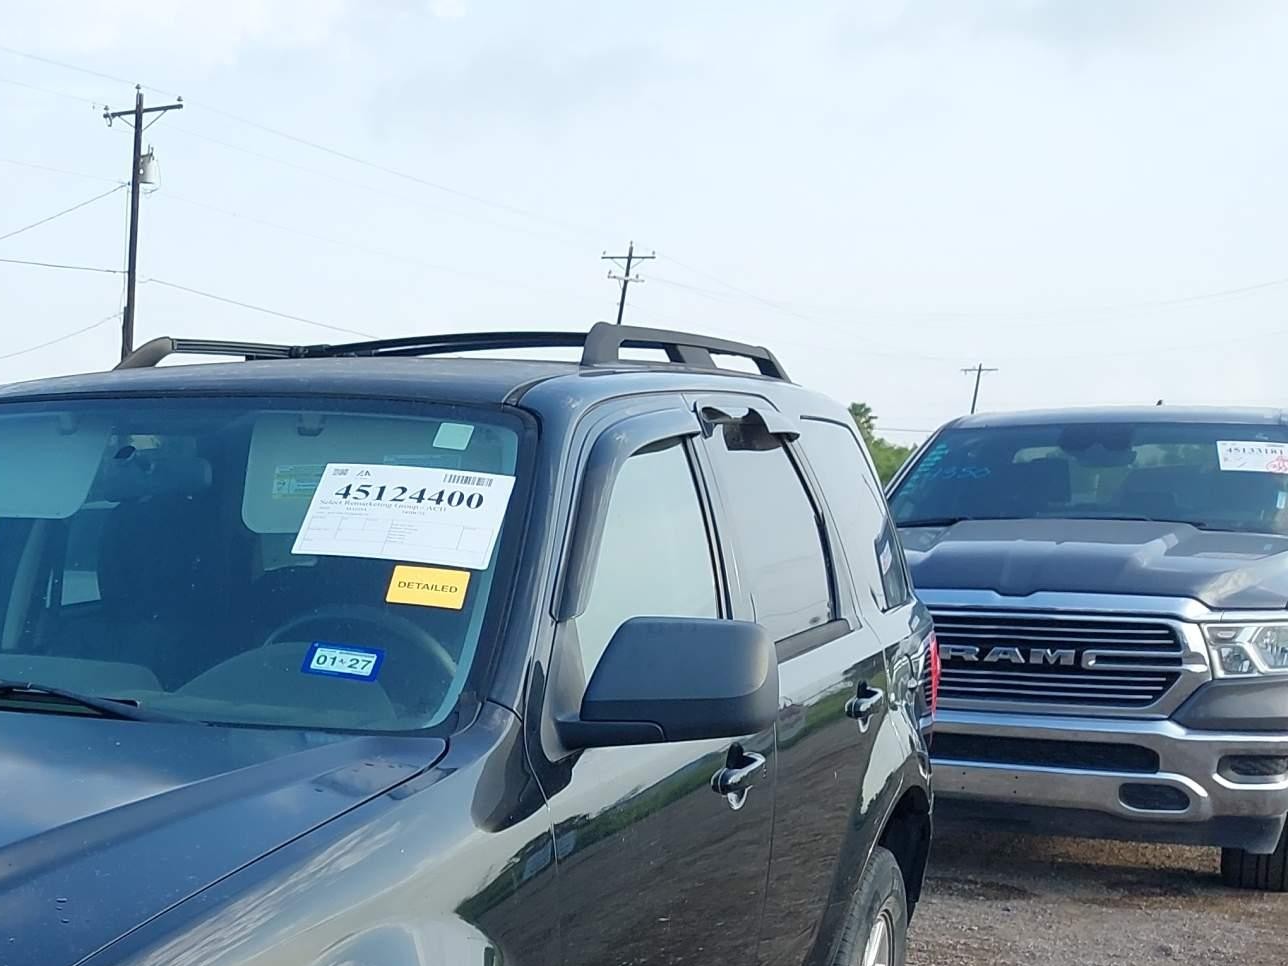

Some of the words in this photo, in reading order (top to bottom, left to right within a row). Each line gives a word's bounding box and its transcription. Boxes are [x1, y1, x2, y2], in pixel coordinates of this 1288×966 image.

[334, 483, 484, 510] 45124400
[397, 580, 459, 595] DETAILED
[939, 643, 1076, 666] RAM
